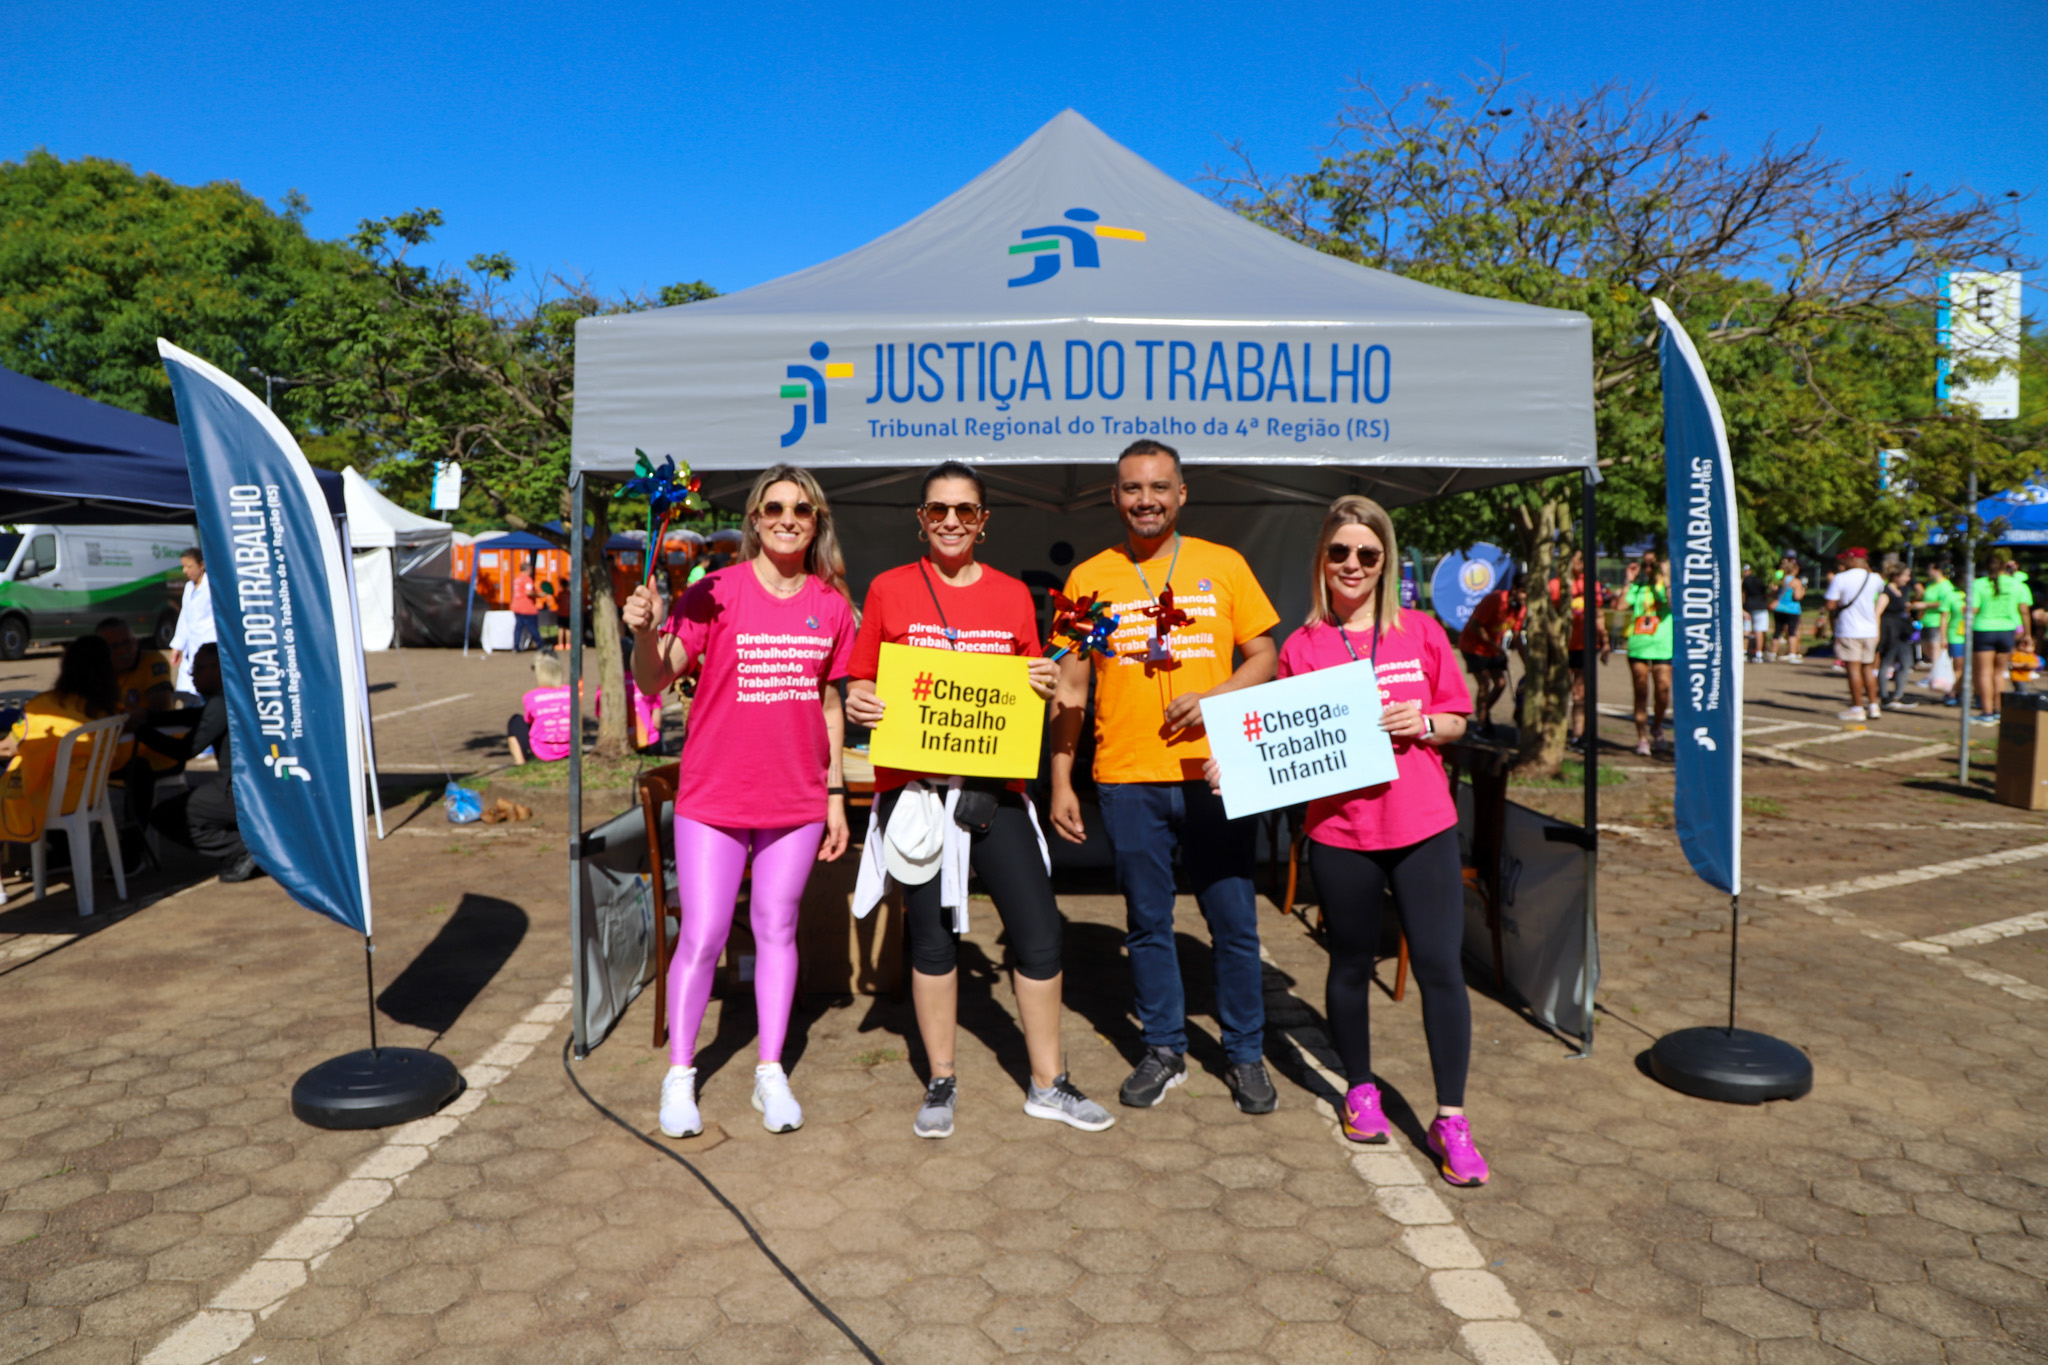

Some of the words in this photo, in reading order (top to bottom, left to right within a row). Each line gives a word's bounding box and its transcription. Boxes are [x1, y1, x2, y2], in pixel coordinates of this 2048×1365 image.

[866, 341, 1052, 411] JUSTIÇA
[1065, 340, 1125, 400] DO
[1135, 340, 1391, 404] TRABALHO
[868, 419, 958, 438] Tribunal
[965, 417, 1062, 441] Regional
[1068, 416, 1095, 435] do
[1101, 416, 1197, 435] Trabalho
[1203, 417, 1229, 436] da
[1235, 416, 1260, 437] 4ª
[1267, 417, 1341, 442] Região
[1346, 418, 1390, 442] (RS)
[265, 484, 281, 508] (RS)
[269, 508, 285, 547] Região
[229, 485, 274, 612] TRABALHO
[276, 563, 287, 578] da
[279, 579, 292, 627] Trabalho
[1682, 588, 1713, 619] DO
[242, 613, 277, 646] DO
[283, 628, 295, 643] do
[284, 644, 301, 693] Regional
[737, 662, 804, 673] CombateAo
[248, 649, 286, 741] JUSTIÇA
[1706, 667, 1721, 711] Tribunal
[288, 693, 303, 739] Tribunal
[919, 704, 1006, 731] Trabalho
[921, 730, 998, 755] Infantil
[1256, 728, 1347, 762] Trabalho
[1268, 749, 1347, 786] Infantil
